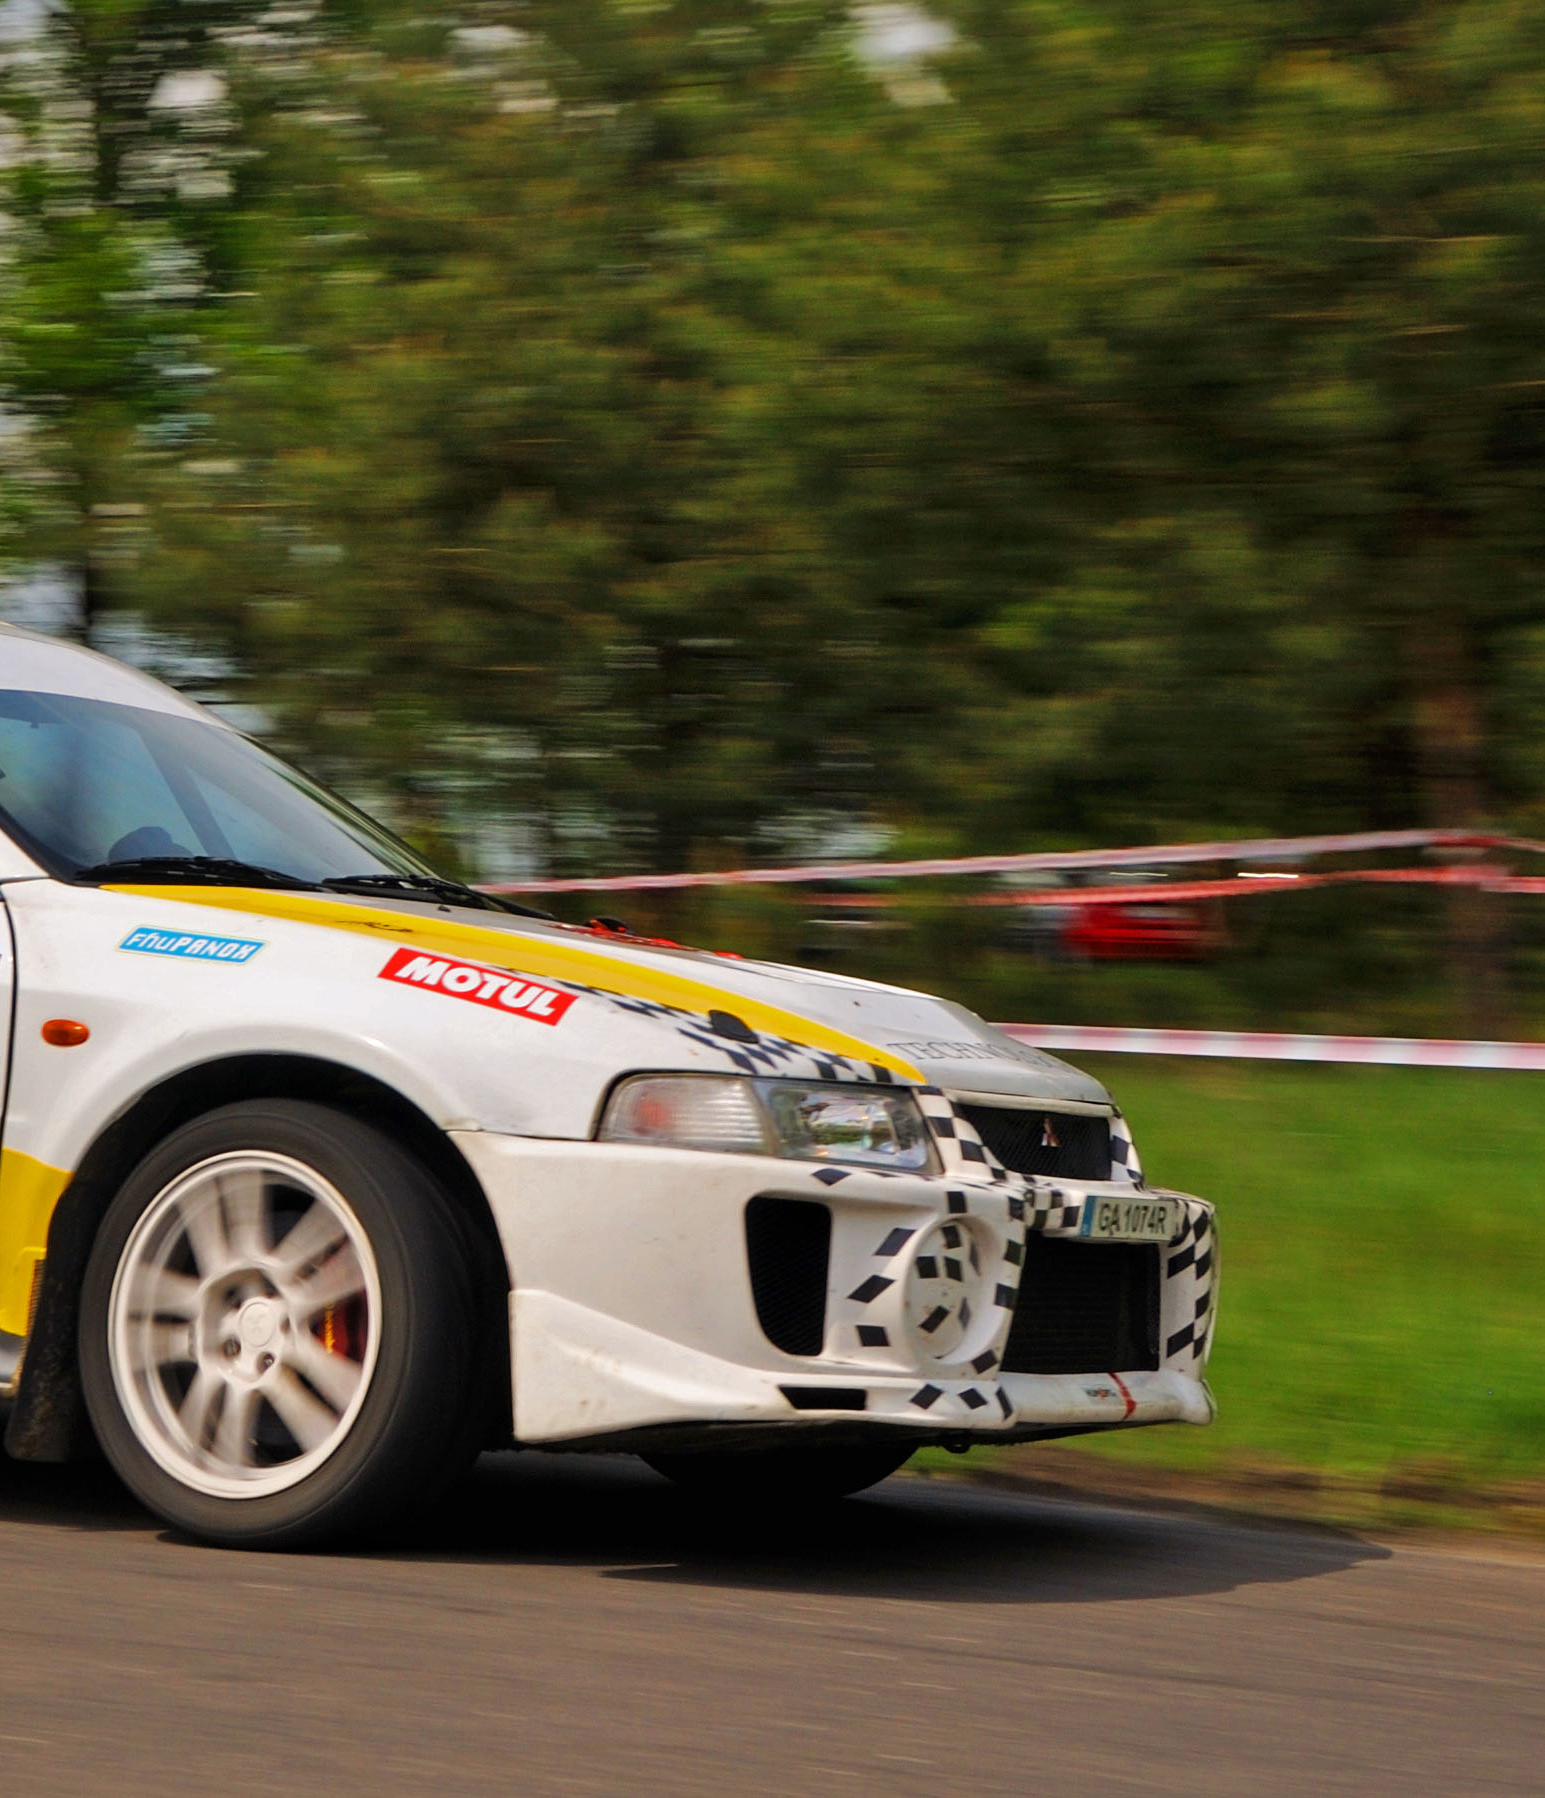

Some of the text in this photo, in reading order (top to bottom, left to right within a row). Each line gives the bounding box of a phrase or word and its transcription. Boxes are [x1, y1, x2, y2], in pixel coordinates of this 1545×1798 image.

[394, 956, 560, 1016] MOTUL
[1099, 1203, 1167, 1234] GA 1074R
